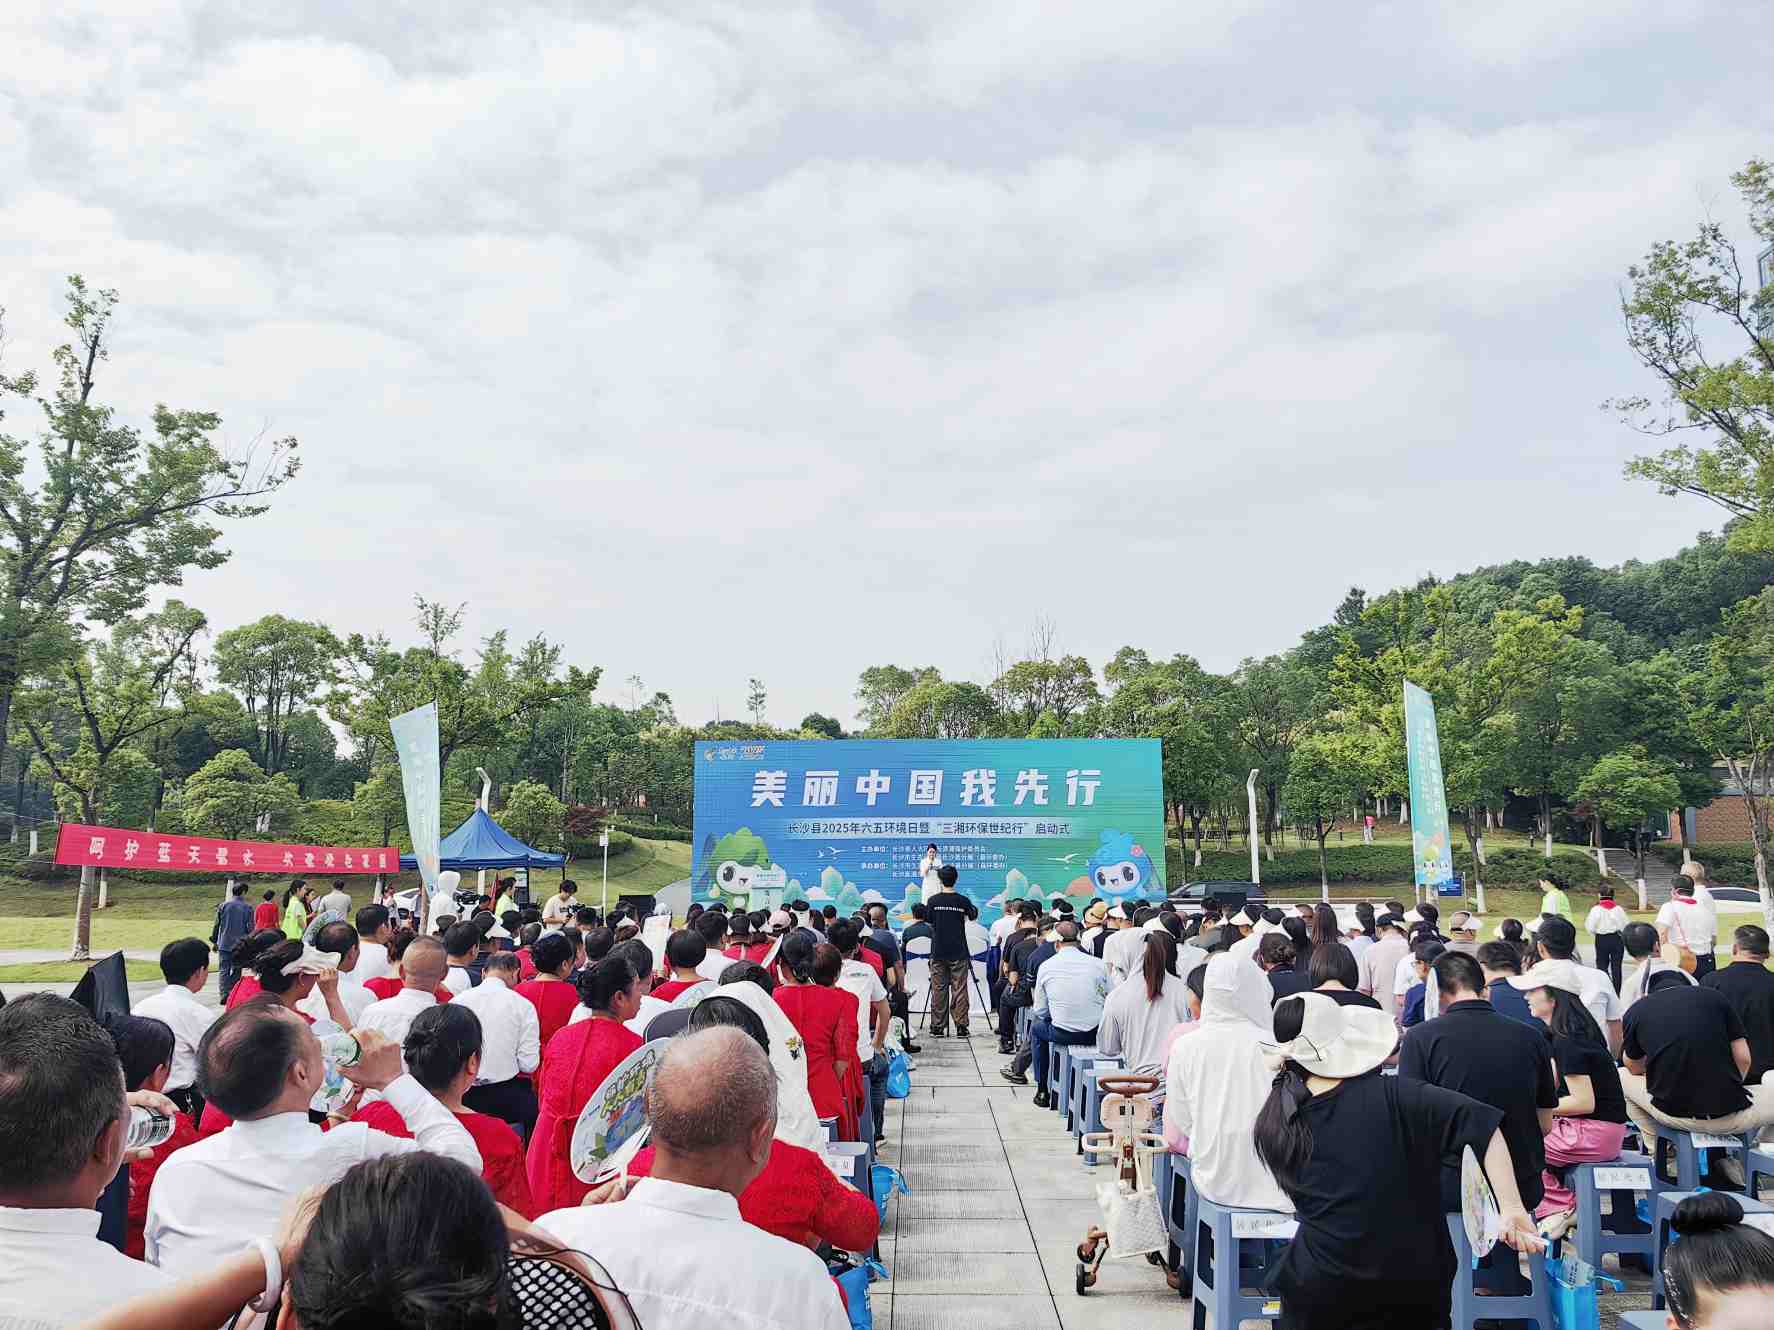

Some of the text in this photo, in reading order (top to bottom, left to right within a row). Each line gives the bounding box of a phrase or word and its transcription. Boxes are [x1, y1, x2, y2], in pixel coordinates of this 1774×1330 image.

[750, 768, 1103, 808] 美丽中国我先行
